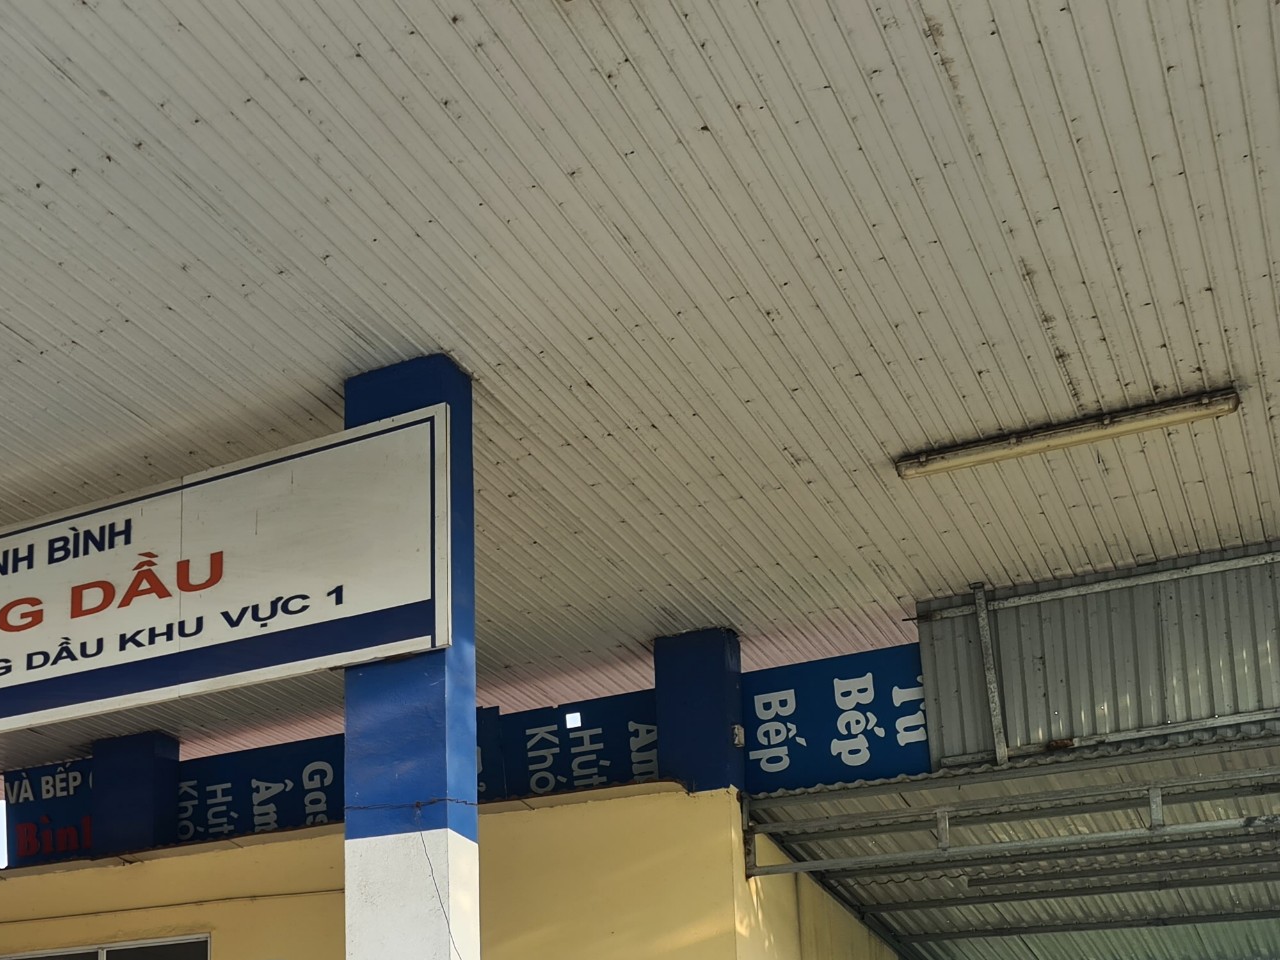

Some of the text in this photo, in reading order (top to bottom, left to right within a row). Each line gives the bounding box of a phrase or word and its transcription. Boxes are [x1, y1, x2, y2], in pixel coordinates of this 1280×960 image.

[47, 518, 132, 565] BÌNH
[70, 550, 224, 620] DẦU
[26, 636, 104, 671] DẦU
[119, 616, 203, 652] KHU
[220, 594, 311, 629] VỰC
[326, 584, 344, 606] 1
[749, 689, 807, 773] Bếp
[830, 672, 885, 767] Bếp
[5, 772, 34, 805] VÀ
[41, 762, 82, 800] BẾP
[525, 724, 568, 795] Khó
[569, 727, 612, 787] Hút
[206, 782, 239, 834] Hút
